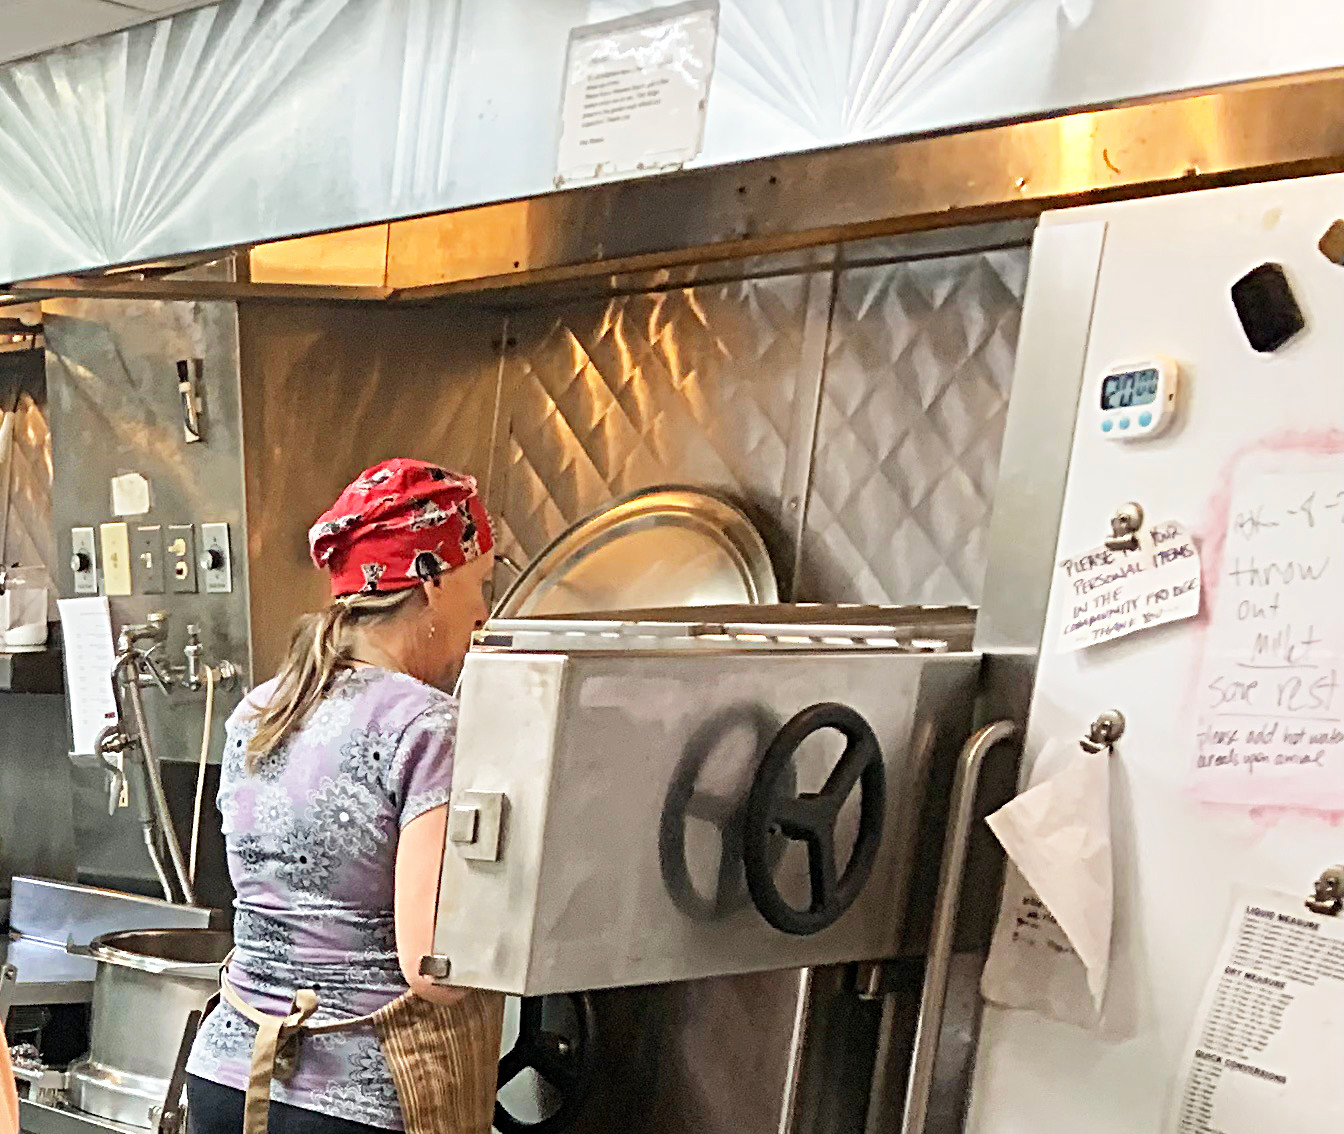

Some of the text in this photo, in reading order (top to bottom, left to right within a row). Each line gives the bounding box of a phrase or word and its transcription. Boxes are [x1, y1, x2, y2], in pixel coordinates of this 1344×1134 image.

[1062, 550, 1115, 577] PLEASE
[1074, 543, 1194, 595] PERSONAL ITEMS
[1229, 556, 1330, 586] throw
[1073, 586, 1123, 618] IN THE
[1238, 592, 1280, 620] out
[1246, 722, 1278, 744] add
[1278, 914, 1320, 931] MEASURE
[1244, 973, 1286, 989] MEASURE
